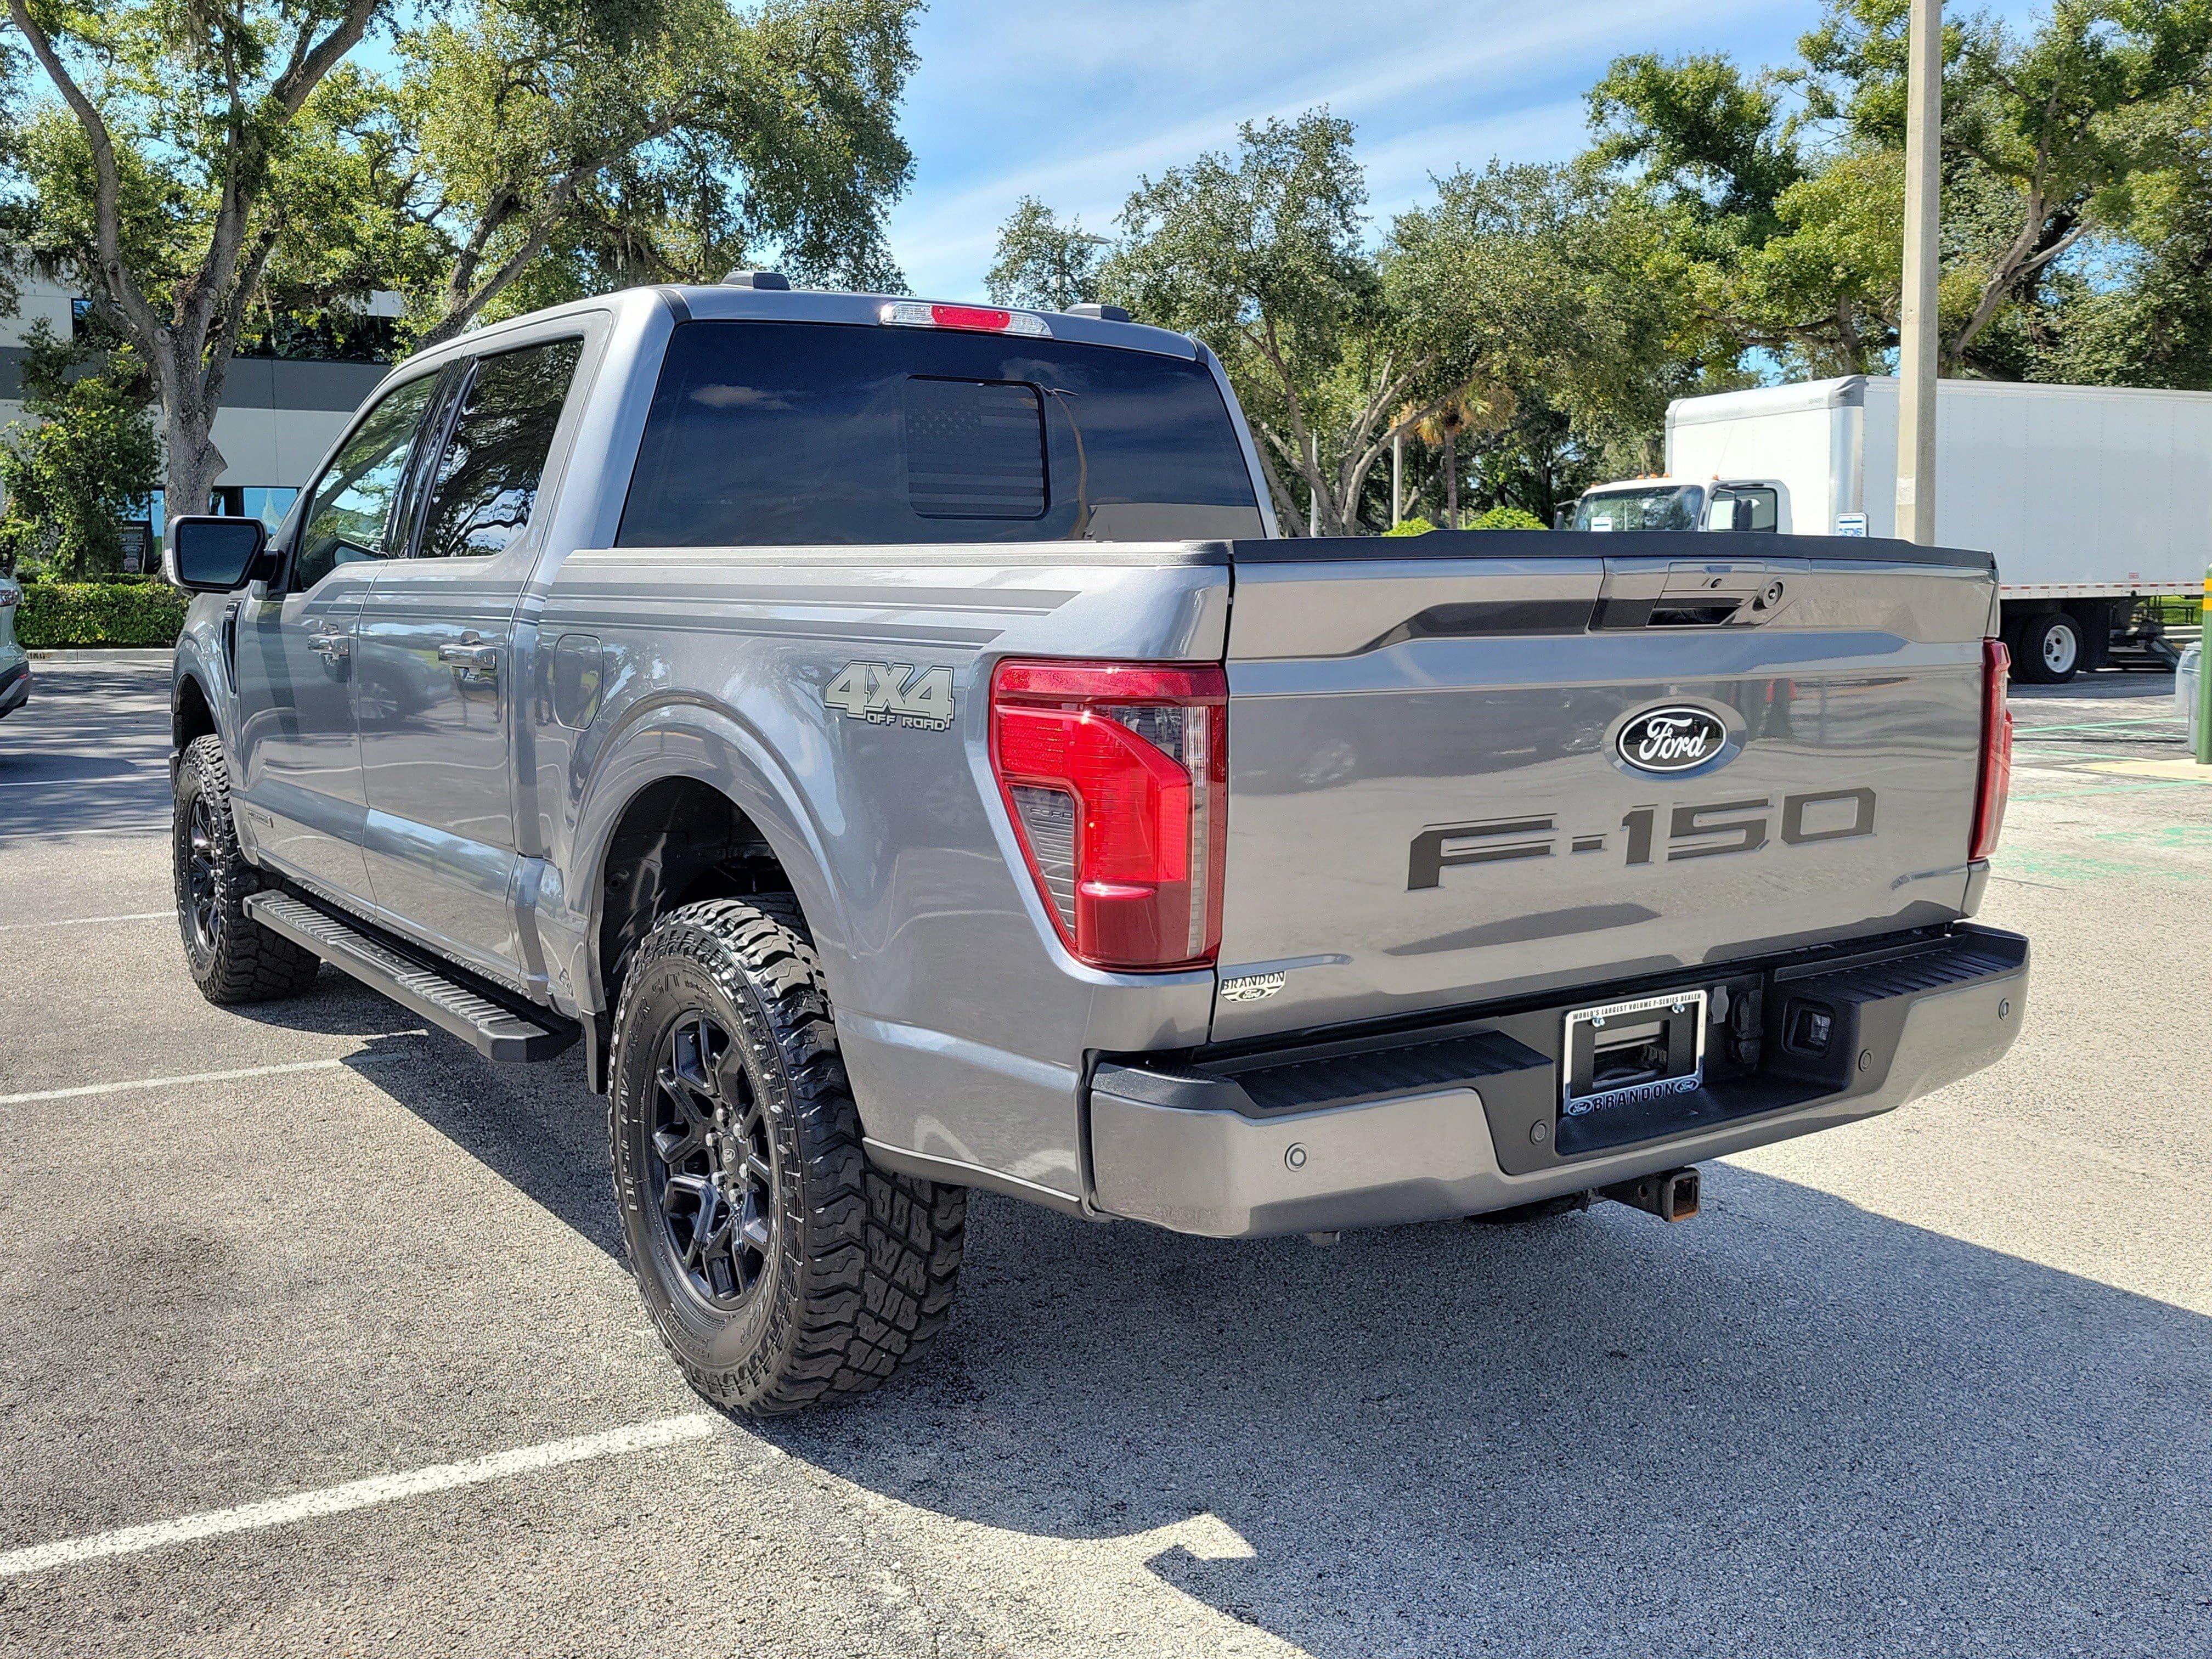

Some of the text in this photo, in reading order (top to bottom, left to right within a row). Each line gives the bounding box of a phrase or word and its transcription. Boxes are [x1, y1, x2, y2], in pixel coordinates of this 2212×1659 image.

[823, 659, 955, 720] 4X4
[866, 713, 948, 732] OFF ROAD
[1639, 716, 1707, 761] Ford
[1030, 808, 1074, 820] FORD
[1406, 787, 1876, 891] F-150
[1221, 971, 1285, 991] BRANDON
[1573, 993, 1701, 1020] WORLD'S LARGEST VOLUME F-SERIES DEALER
[1592, 1082, 1676, 1112] BRANDON
